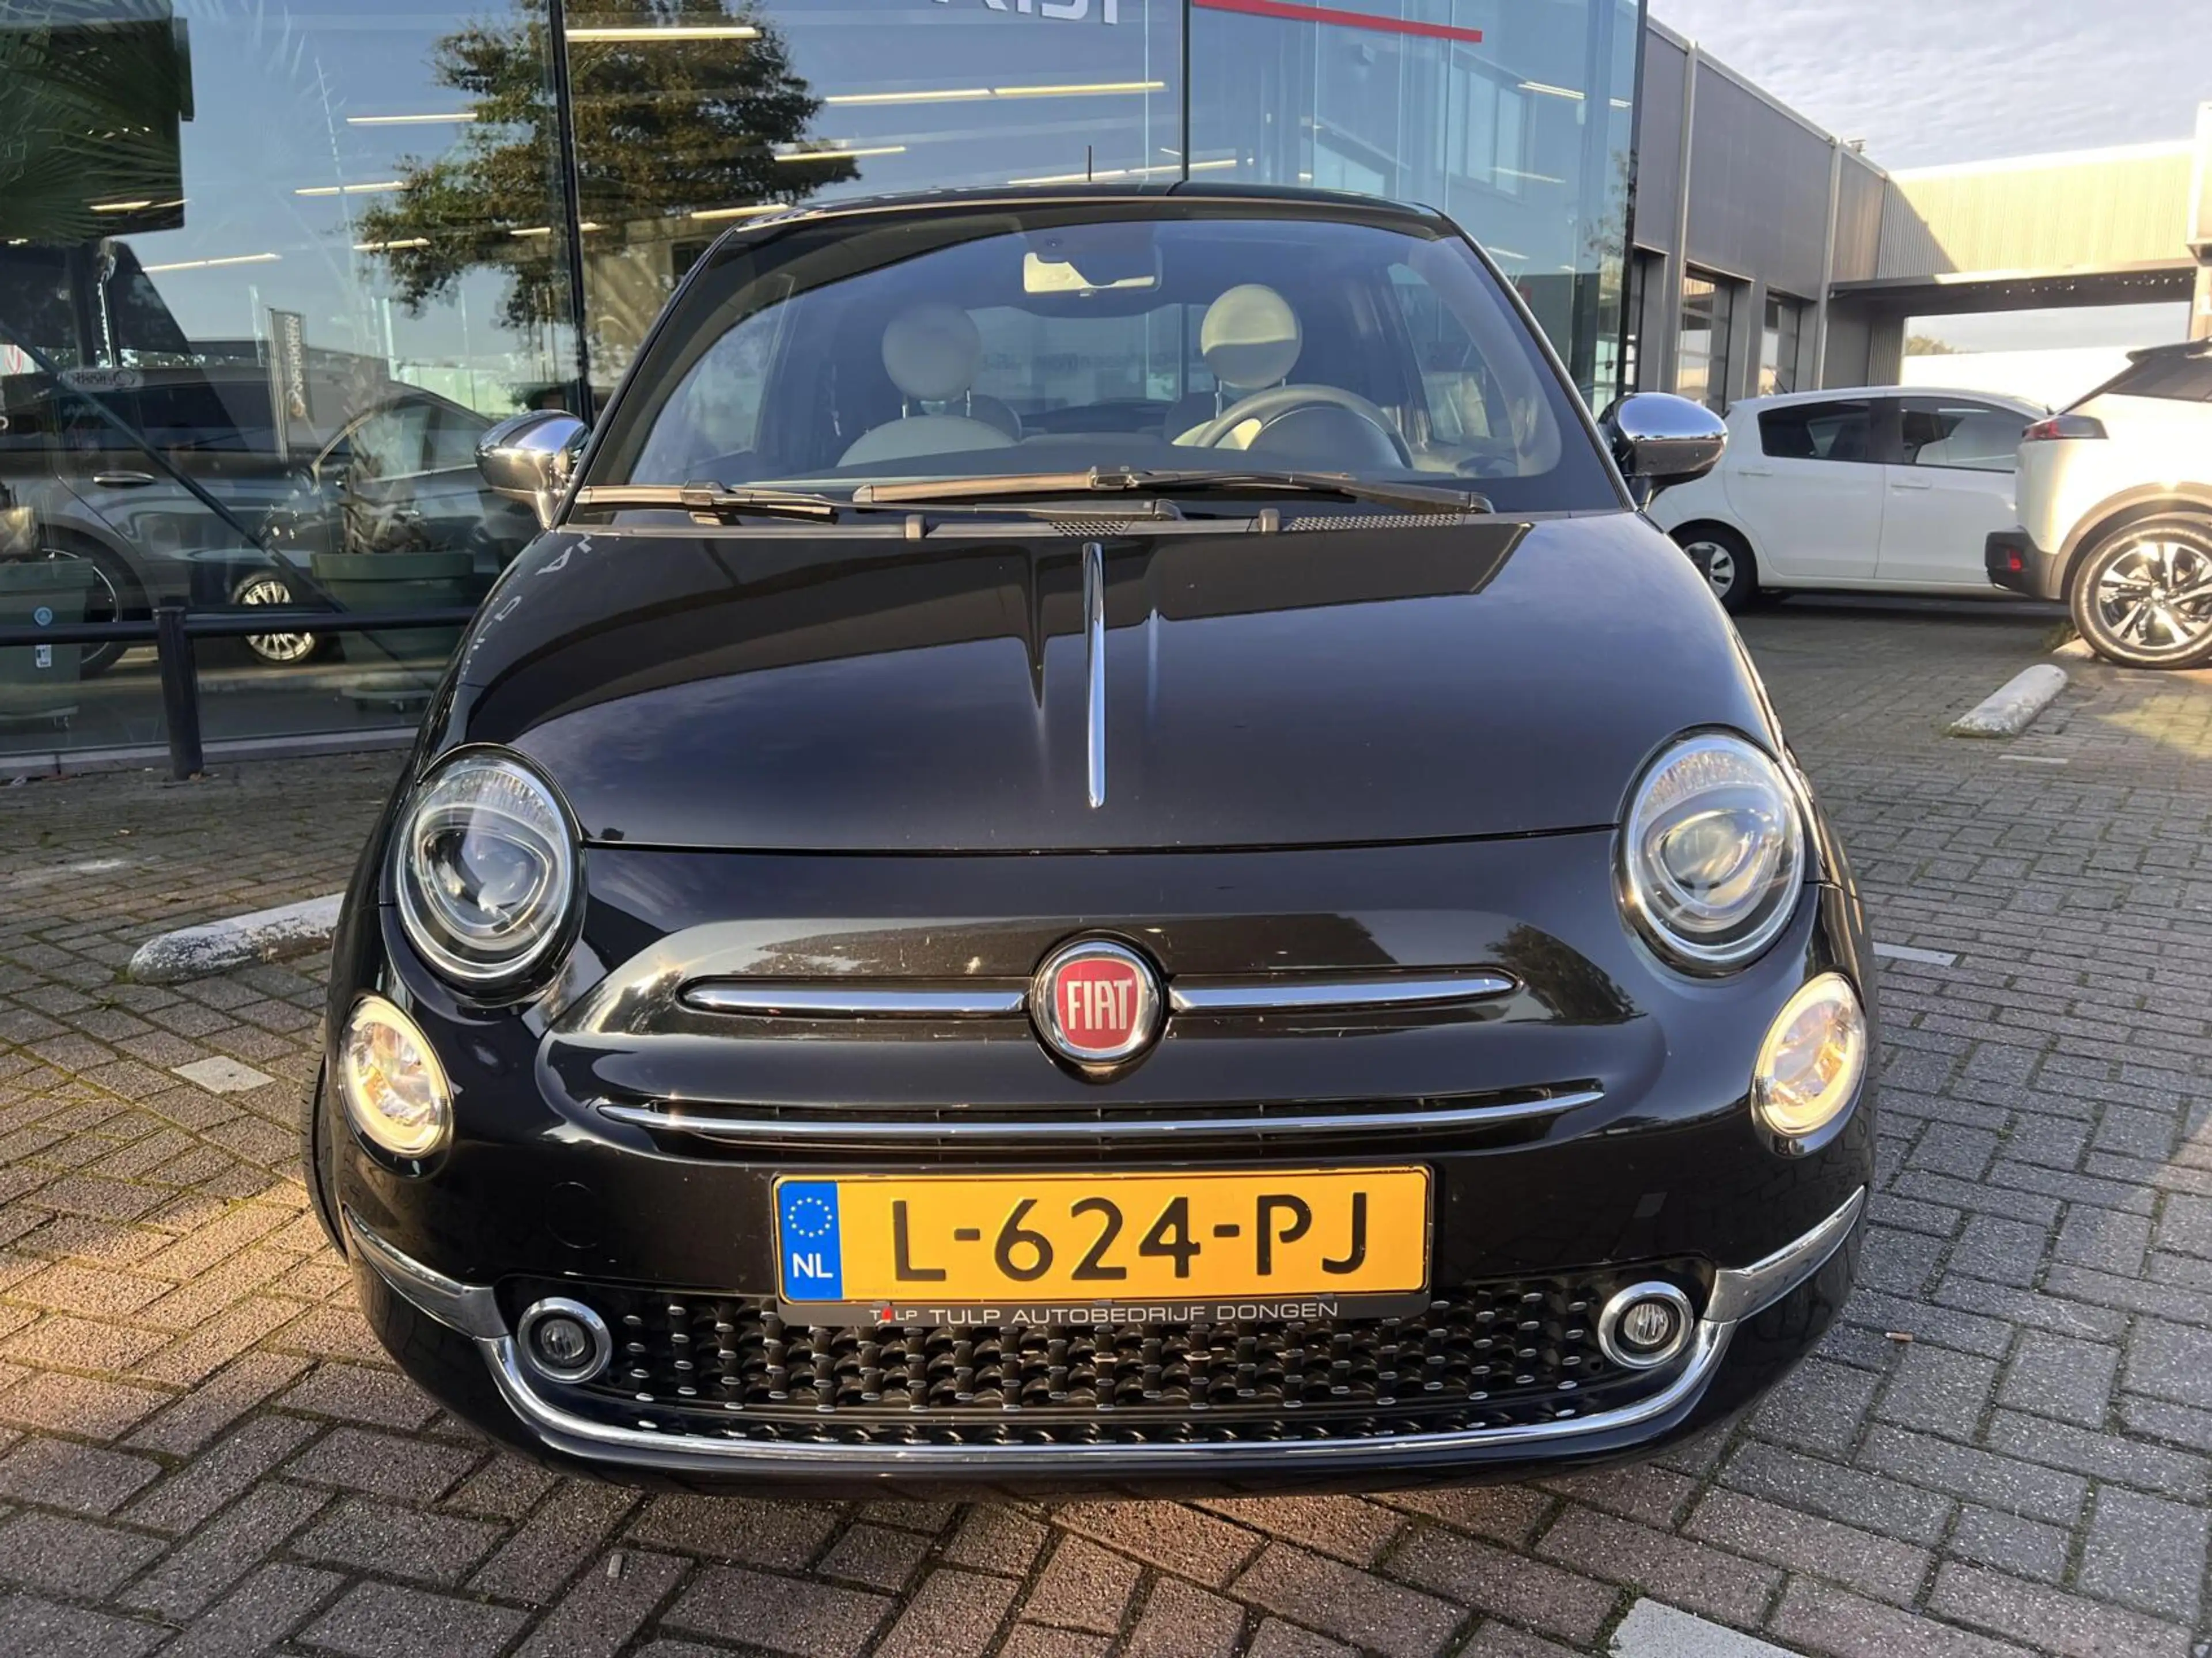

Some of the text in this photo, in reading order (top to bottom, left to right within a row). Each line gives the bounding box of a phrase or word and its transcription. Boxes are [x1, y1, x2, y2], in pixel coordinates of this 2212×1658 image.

[1066, 980, 1132, 1030] FIAT
[891, 1192, 1369, 1281] L-624-PJ
[791, 1251, 834, 1279] NL
[929, 1309, 1001, 1324] TULP
[1011, 1306, 1205, 1325] AUTOBEDRIJF
[1217, 1302, 1338, 1320] DONGEN
